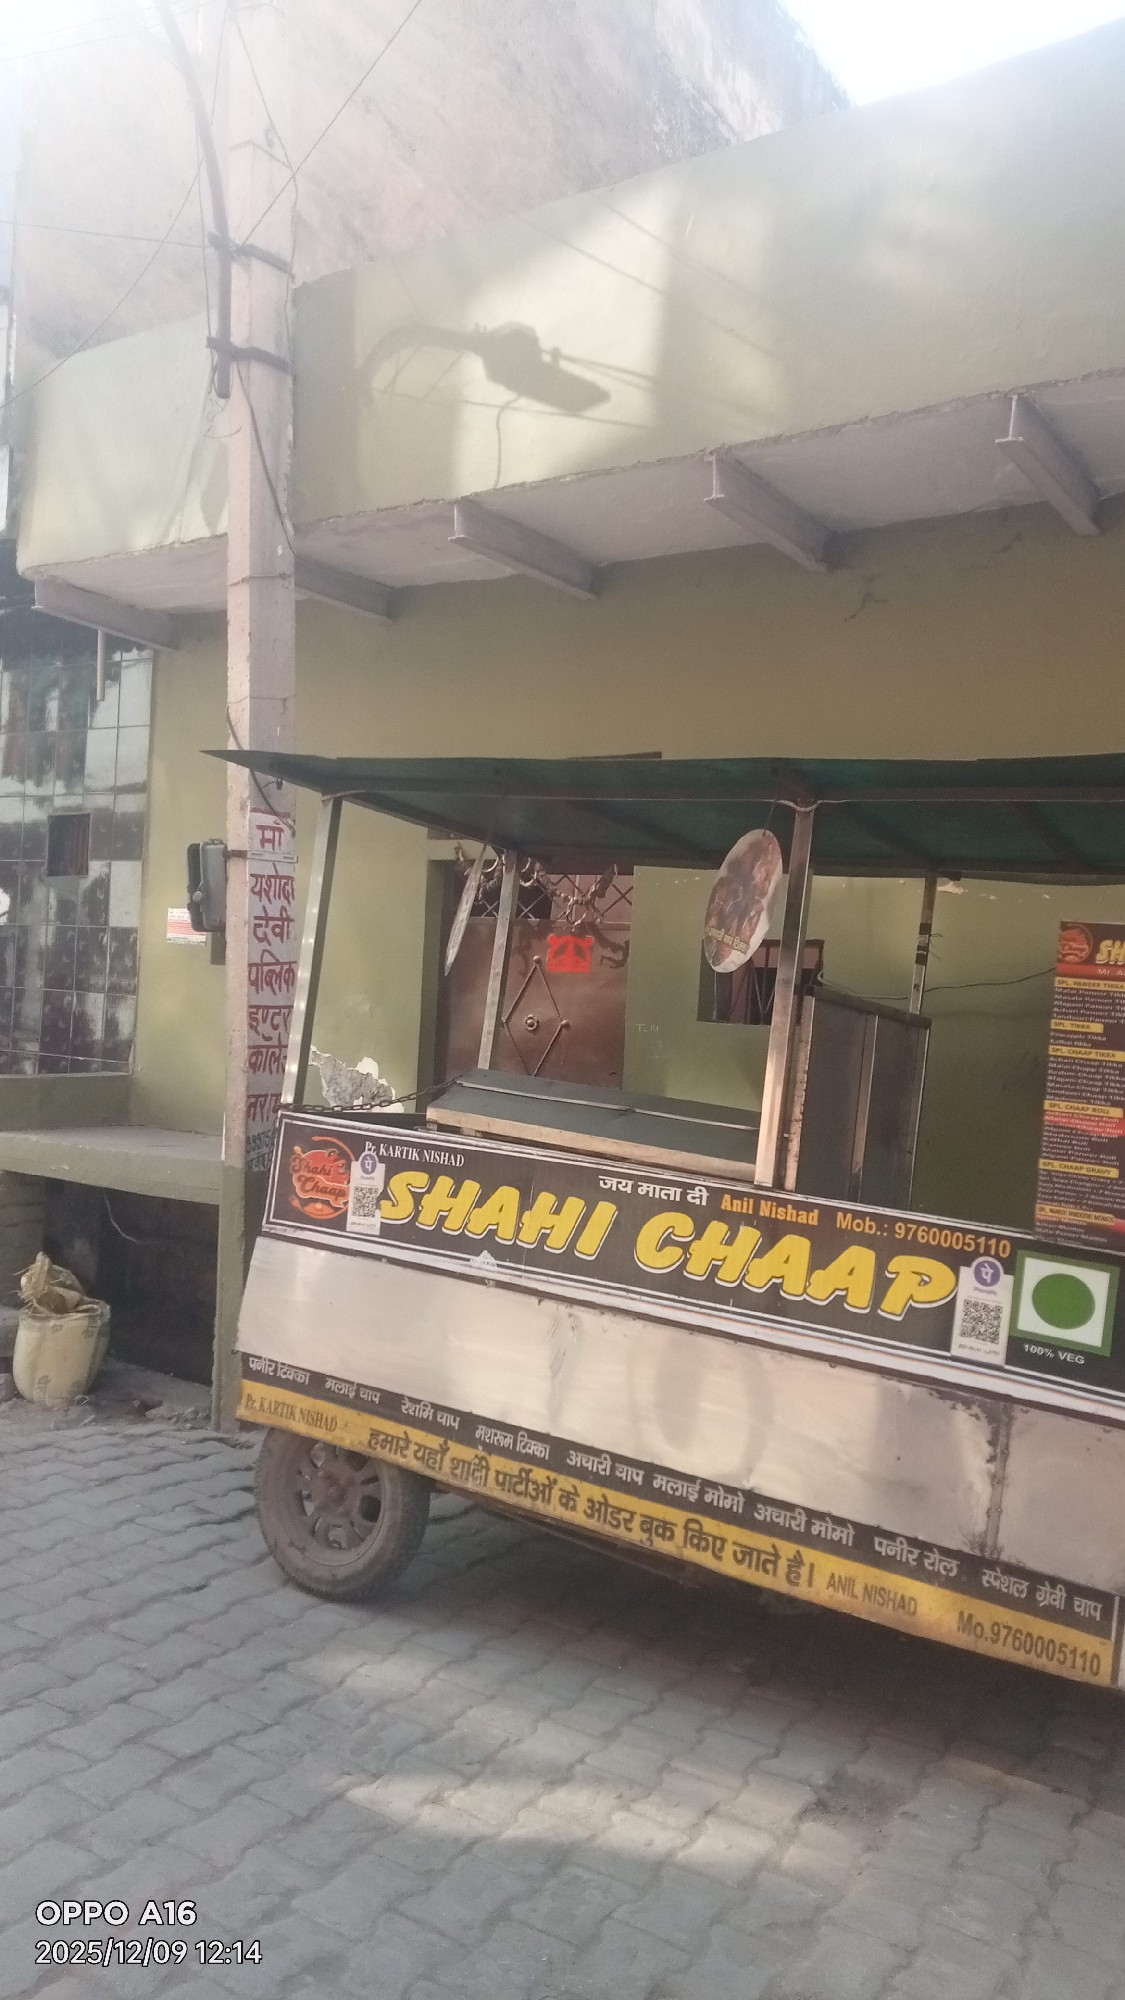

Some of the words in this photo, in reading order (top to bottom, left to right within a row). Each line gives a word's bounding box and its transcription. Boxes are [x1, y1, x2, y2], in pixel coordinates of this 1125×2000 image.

[250, 862, 295, 906] यशोदा
[253, 905, 294, 946] देवी
[248, 949, 297, 996] पब्लिक
[379, 1144, 420, 1161] KARTIK
[423, 1149, 464, 1167] NISHAD
[297, 1174, 346, 1201] Chaap
[599, 1175, 634, 1194] जय
[637, 1181, 683, 1202] माता
[686, 1185, 709, 1207] दी
[720, 1193, 754, 1215] Anil
[759, 1199, 820, 1226] Nishad
[380, 1170, 619, 1261] SHAHI
[633, 1211, 958, 1321] CHAAP
[894, 1221, 1012, 1259] 9760005110
[1023, 1344, 1055, 1359] 100%
[1057, 1350, 1085, 1365] VEG
[259, 1396, 298, 1421] KARTIK
[299, 1408, 338, 1433] NISHAD
[249, 1356, 276, 1376] पनीर
[276, 1361, 311, 1386] टिक्का
[325, 1377, 358, 1400] मलाई
[359, 1387, 381, 1405] चाप
[400, 1394, 434, 1422] रेशमि
[436, 1410, 461, 1430] चाप
[516, 1430, 551, 1461] टिक्का
[566, 1449, 613, 1477] अचारी
[614, 1461, 646, 1486] चाप
[652, 1472, 702, 1503] मलाई
[704, 1484, 746, 1514] मोमो
[753, 1503, 808, 1533] अचारी
[811, 1516, 856, 1547] मोमो
[873, 1536, 922, 1566] पनीर
[922, 1547, 960, 1578] रोल
[981, 1566, 1031, 1599] स्पेशल
[1073, 1596, 1102, 1622] चाप
[368, 1427, 412, 1459] हमारे
[558, 1483, 581, 1513] के
[639, 1512, 678, 1547] बुक
[682, 1517, 728, 1560] किए
[732, 1541, 782, 1578] जाते
[826, 1572, 859, 1600] ANIL
[862, 1582, 918, 1617] NISHAD
[957, 1610, 1102, 1677] Mo.9760005110
